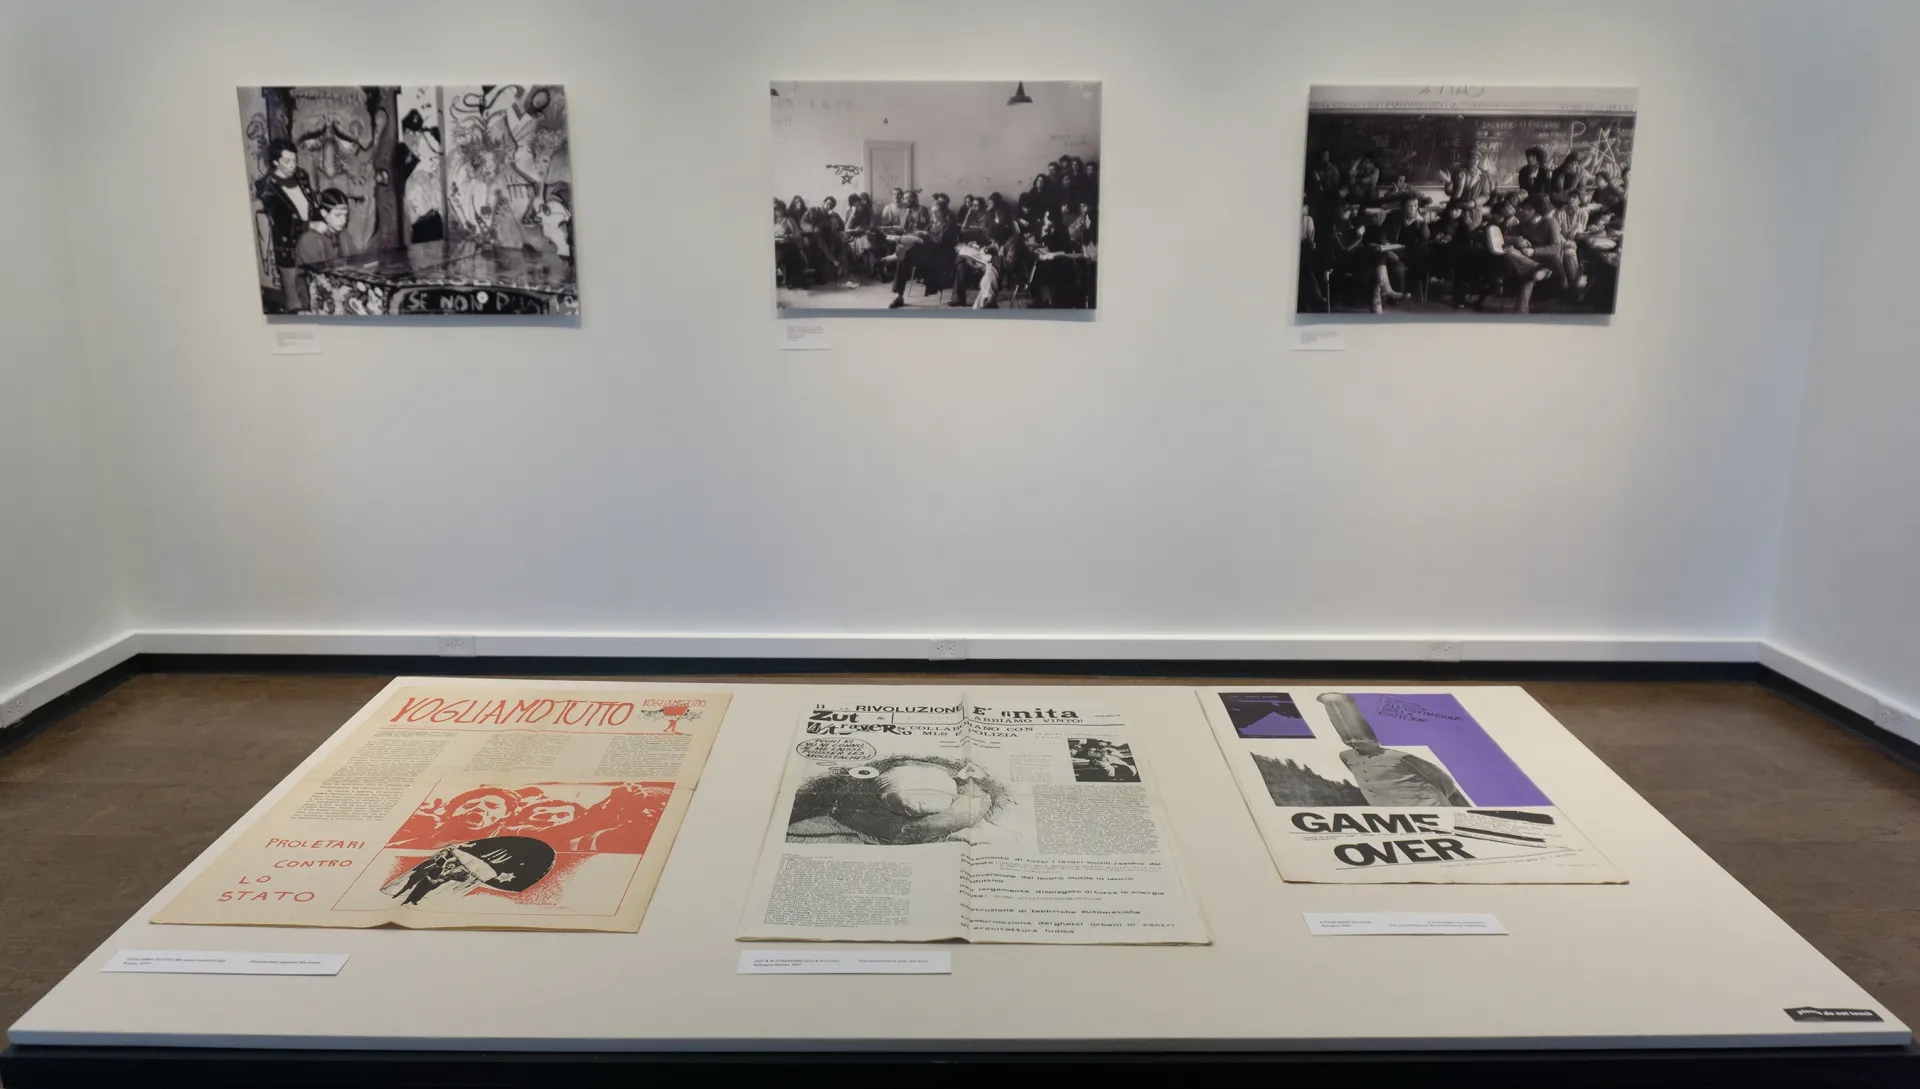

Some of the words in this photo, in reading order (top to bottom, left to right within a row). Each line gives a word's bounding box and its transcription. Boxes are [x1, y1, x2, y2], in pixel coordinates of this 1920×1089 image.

[856, 702, 964, 712] RIVOLUZIONE
[1001, 708, 1079, 718] finita
[809, 710, 860, 723] Zut
[968, 728, 1019, 738] POLIZIA
[1291, 812, 1449, 834] GAME
[265, 838, 365, 849] PROLETARI
[1334, 838, 1477, 866] OVER
[274, 860, 352, 868] CONTRO
[238, 876, 272, 884] LO
[217, 891, 316, 902] STATO
